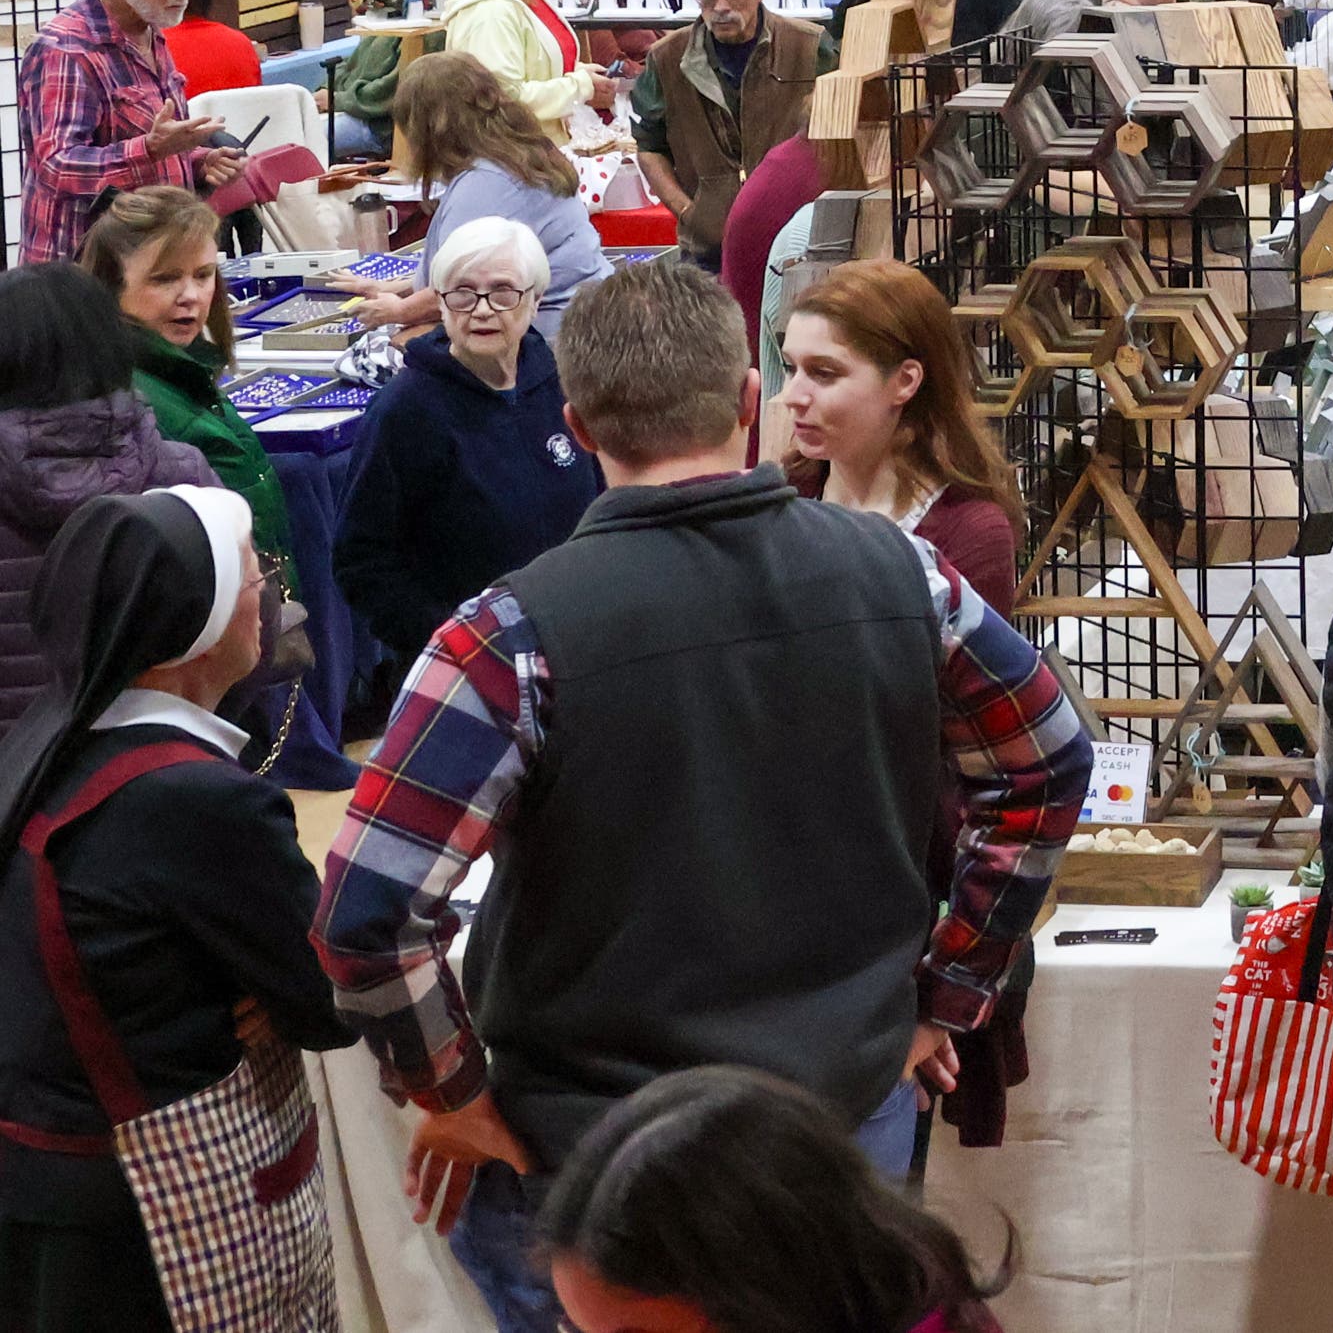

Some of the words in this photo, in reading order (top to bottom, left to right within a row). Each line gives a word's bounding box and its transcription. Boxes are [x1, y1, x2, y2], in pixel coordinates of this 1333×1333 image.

[1097, 747, 1140, 757] ACCEPT
[1100, 760, 1131, 770] CASH
[1252, 960, 1269, 968] THE
[1244, 968, 1272, 981] CAT
[1317, 972, 1329, 1000] CAT
